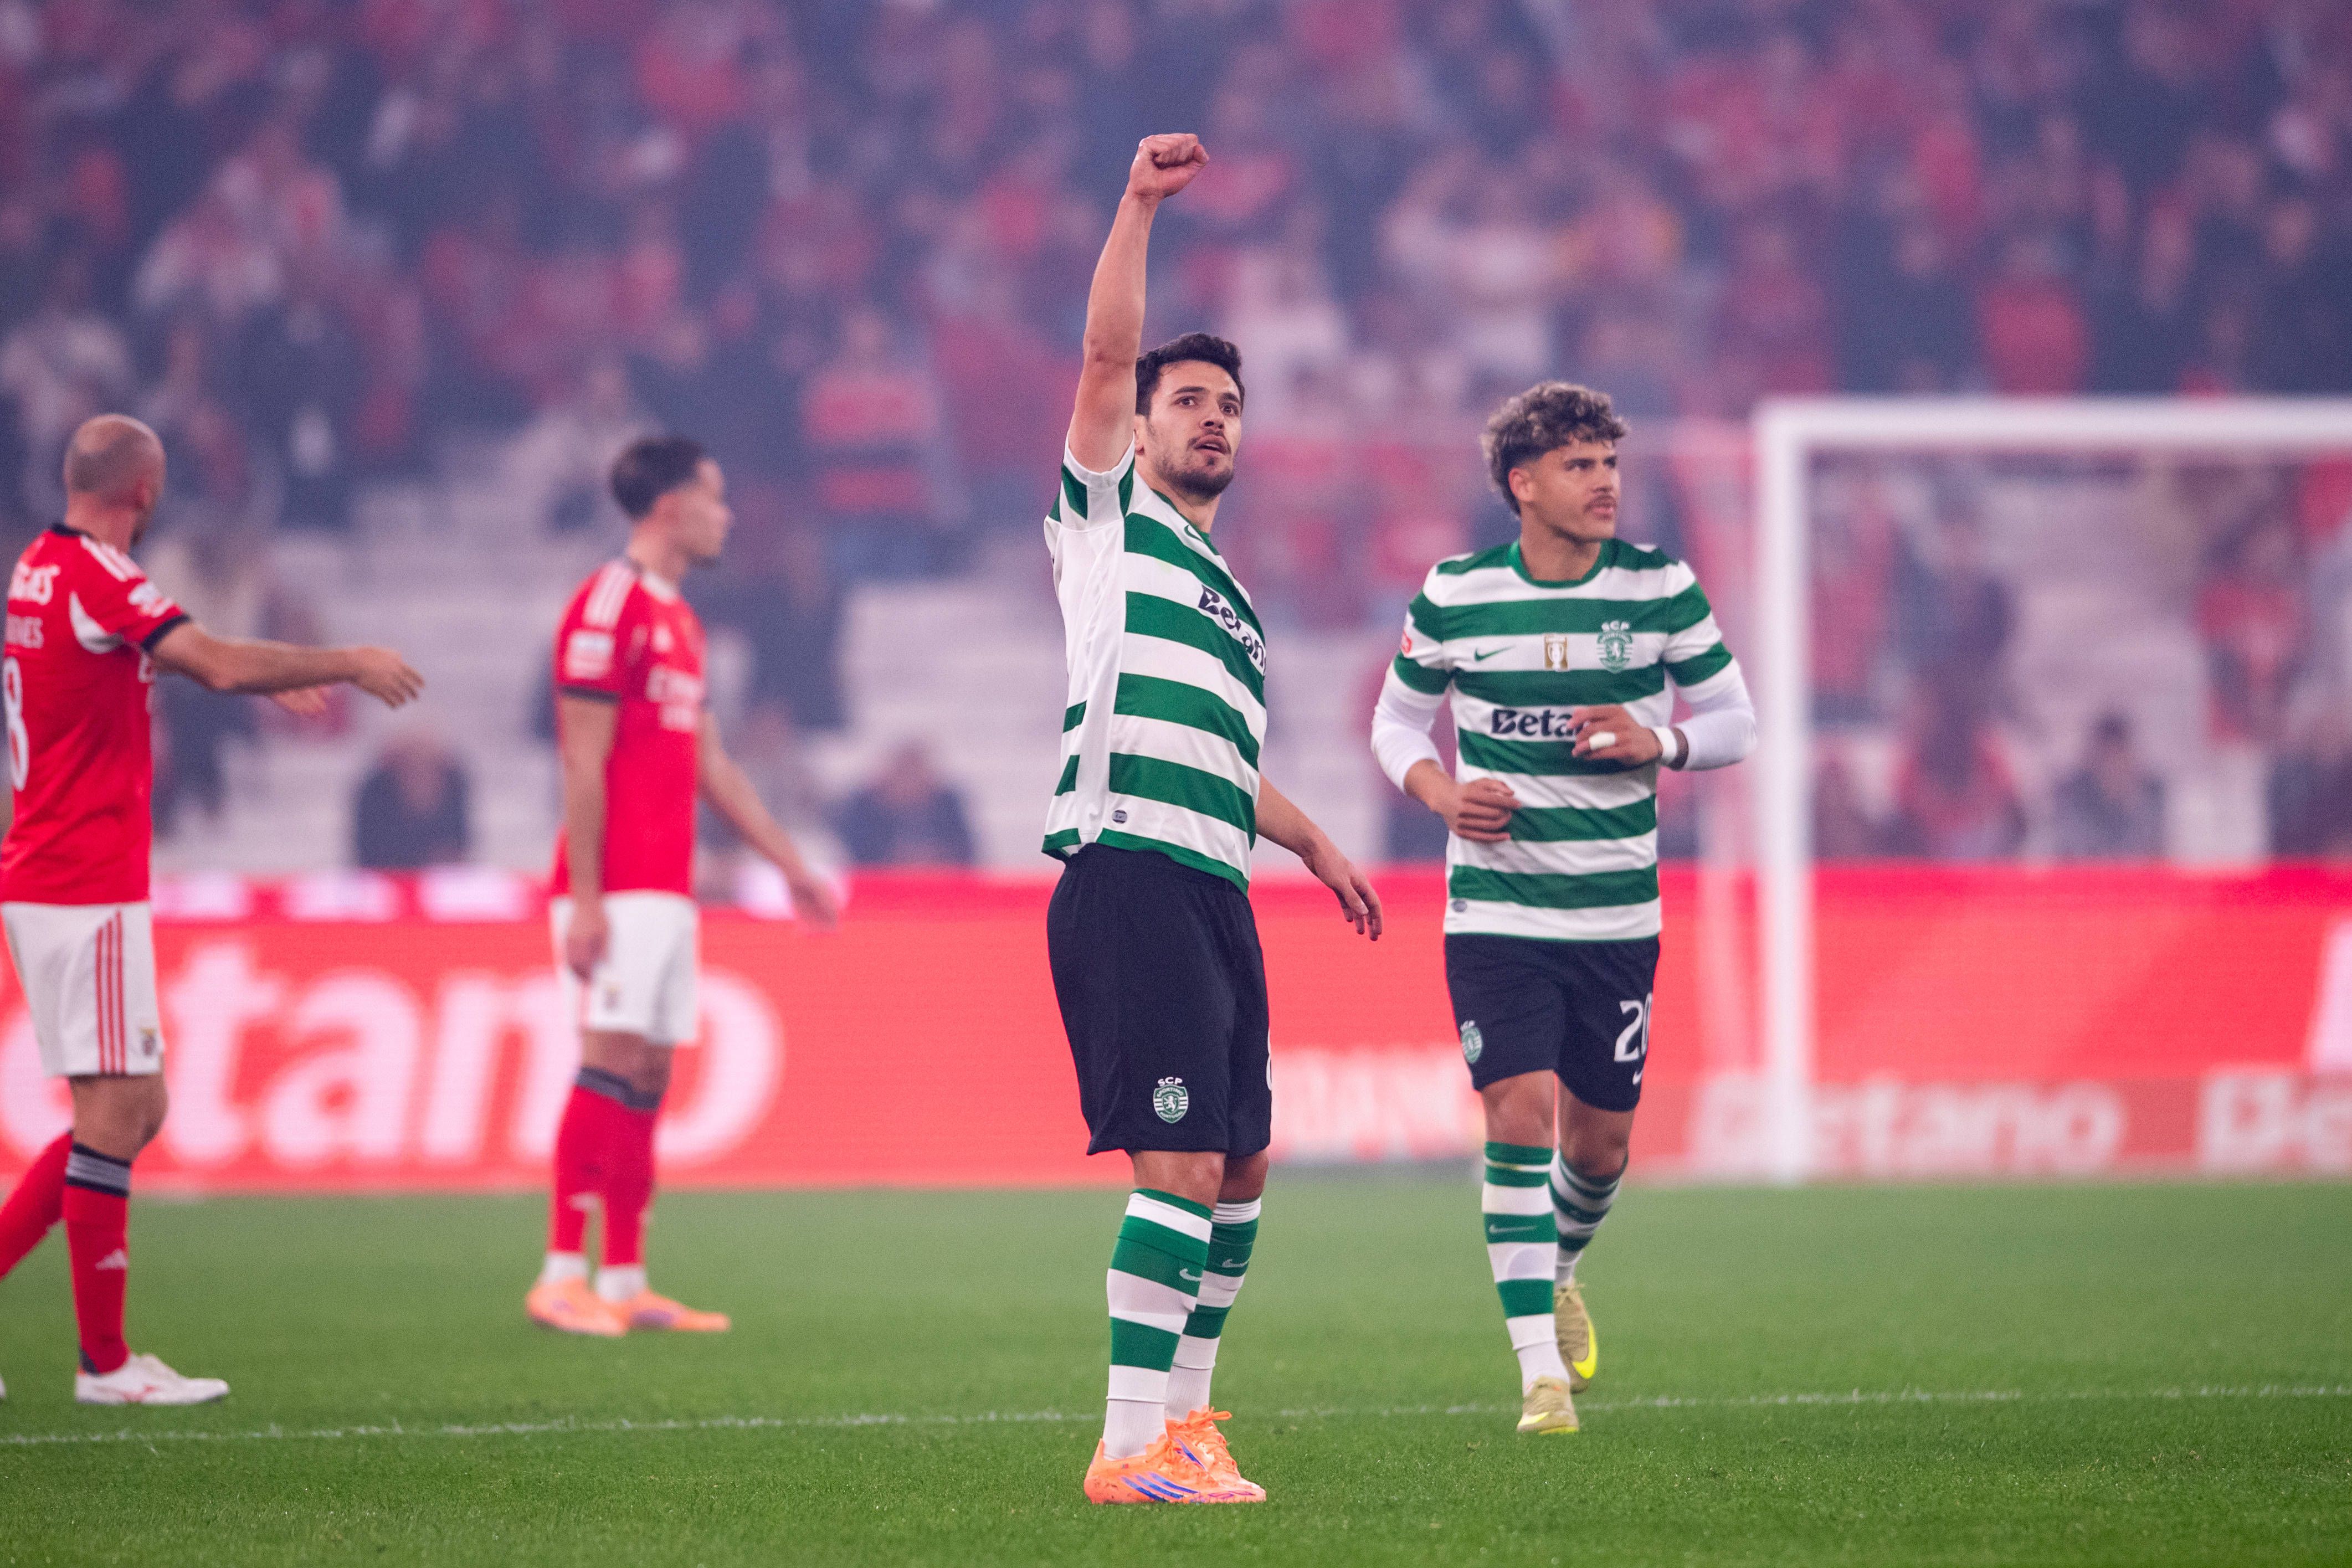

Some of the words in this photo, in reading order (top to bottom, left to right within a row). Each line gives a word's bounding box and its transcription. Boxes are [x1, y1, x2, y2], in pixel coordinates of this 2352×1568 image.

[1198, 584, 1266, 678] Bean
[1601, 620, 1630, 633] SCP
[1491, 708, 1583, 738] Beta
[1157, 1076, 1183, 1087] SCP
